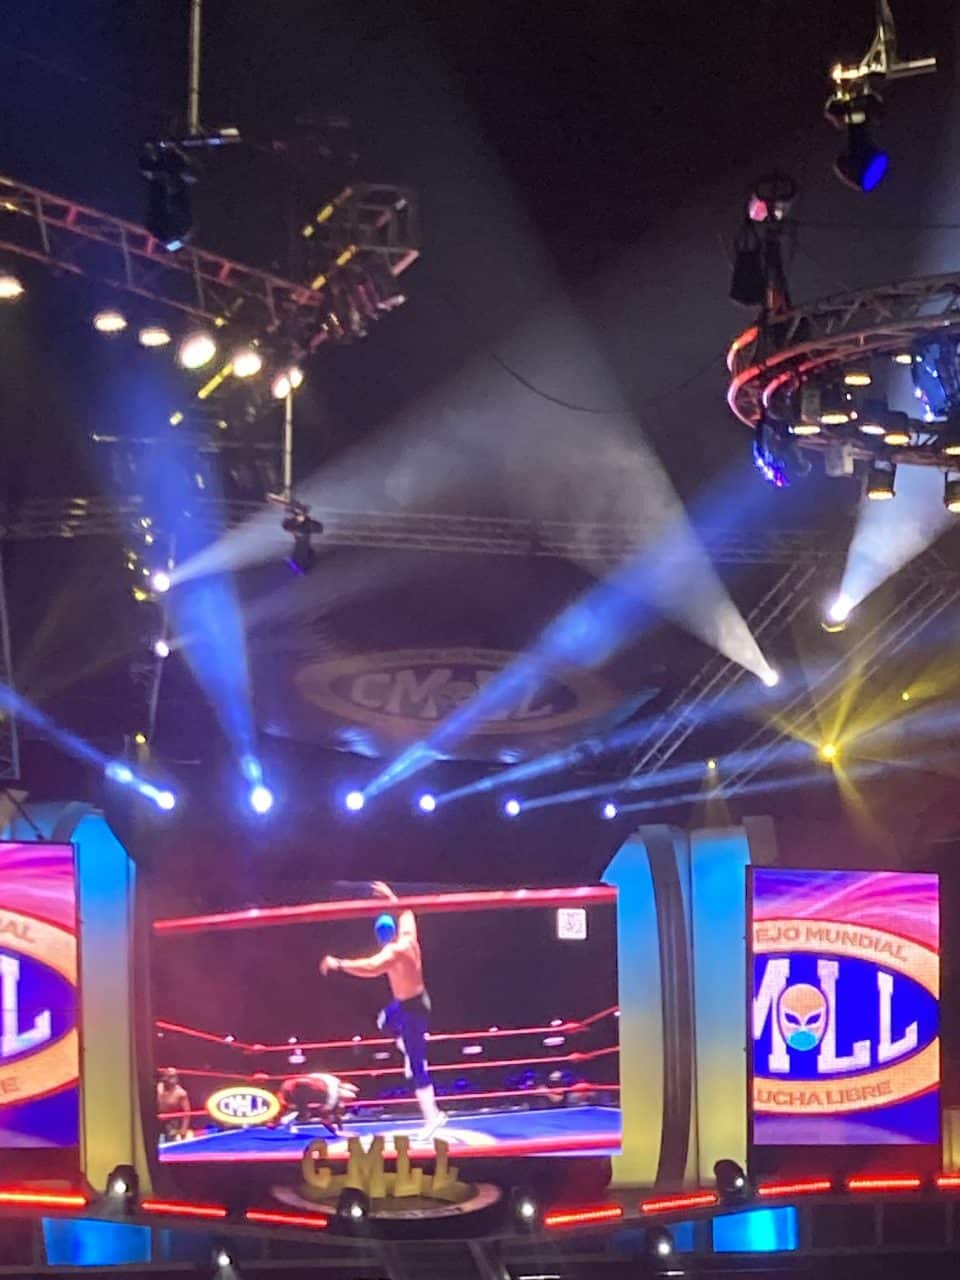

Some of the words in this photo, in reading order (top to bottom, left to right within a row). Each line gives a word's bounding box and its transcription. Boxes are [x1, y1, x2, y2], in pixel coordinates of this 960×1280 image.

[805, 928, 908, 962] MUNDIAL
[826, 1081, 893, 1106] LIBRE
[301, 1135, 459, 1198] CMLL
